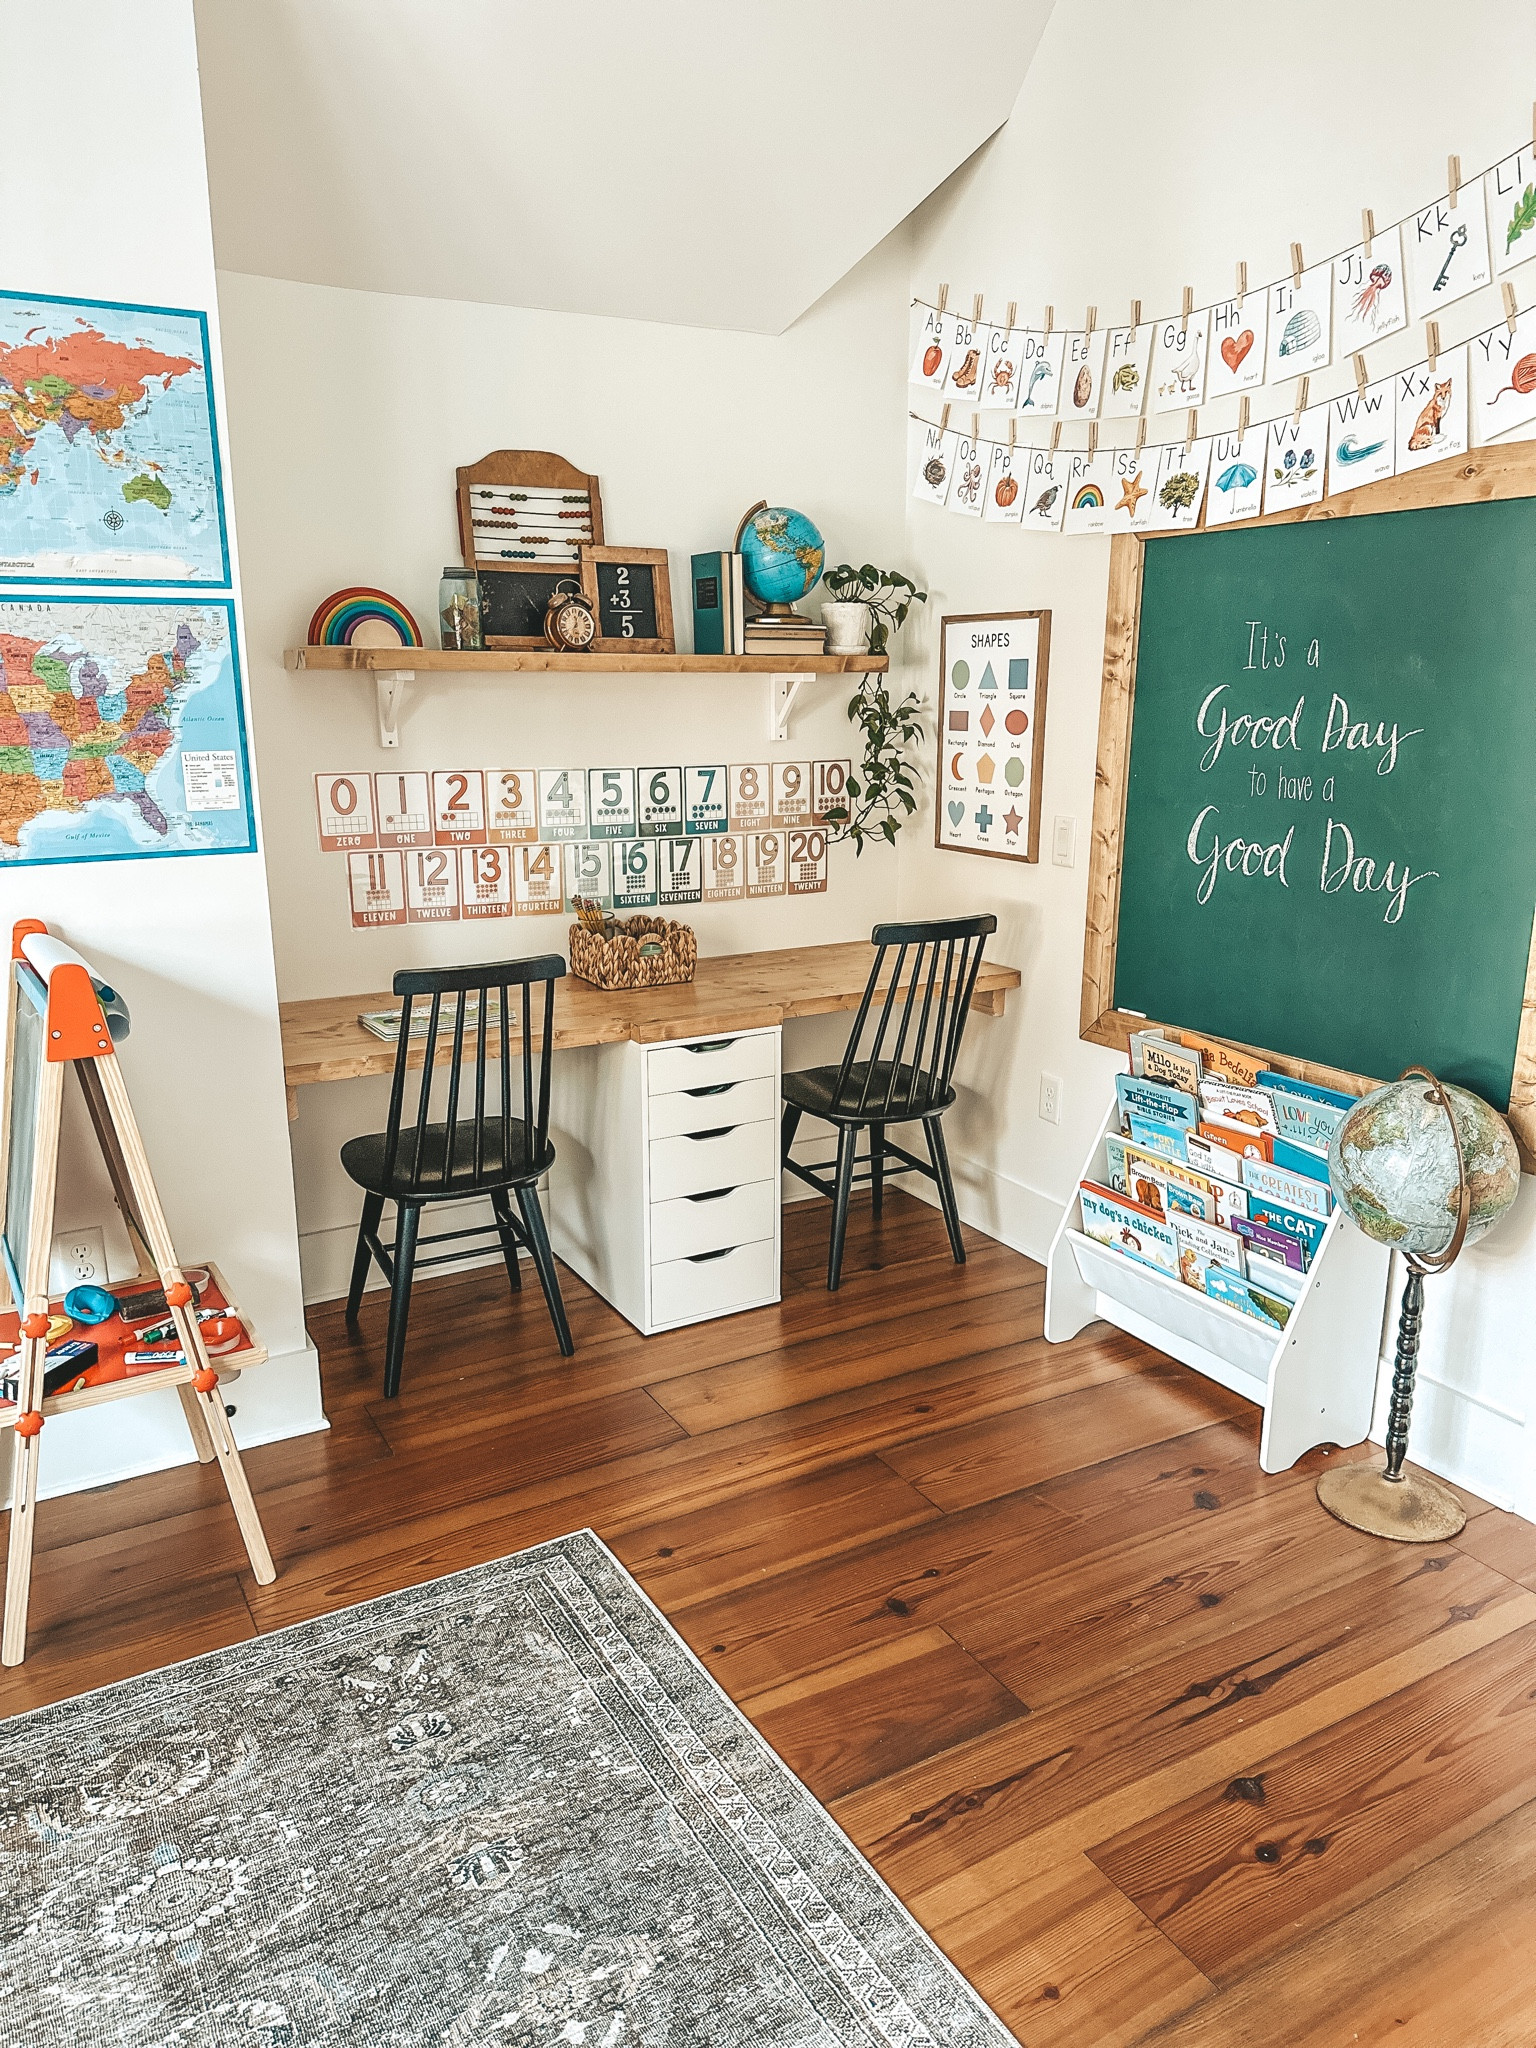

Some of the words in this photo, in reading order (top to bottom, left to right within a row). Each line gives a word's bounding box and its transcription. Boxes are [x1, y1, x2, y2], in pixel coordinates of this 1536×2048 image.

[1416, 205, 1449, 242] Kk
[1339, 254, 1363, 285] Jj
[1276, 287, 1293, 314] Ii
[1215, 303, 1240, 332] Hh
[955, 324, 972, 346] Bb
[991, 334, 1008, 354] Cc
[1112, 333, 1132, 357] Ff
[1163, 324, 1187, 351] Gg
[1479, 333, 1513, 361] Yy
[1071, 339, 1088, 362] Ee
[1400, 372, 1430, 402] Xx
[1336, 395, 1383, 424] Ww
[926, 428, 941, 450] Nn
[1274, 420, 1300, 446] Vv
[960, 441, 976, 461] Oo
[994, 448, 1010, 473] Pp
[1166, 446, 1186, 470] Tt
[1218, 437, 1242, 461] Uu
[1034, 454, 1054, 480] Qq
[1072, 456, 1090, 478] Rr
[1118, 453, 1136, 476] Ss
[616, 567, 630, 585] 2
[1, 604, 51, 612] CANADA
[622, 616, 634, 638] 5
[971, 632, 1010, 648] SHAPES
[1242, 621, 1287, 670] It's
[1306, 638, 1320, 668] a
[979, 692, 997, 700] Triangle
[1197, 684, 1305, 772] Good
[1322, 692, 1424, 776] Day
[184, 754, 210, 762] United
[500, 773, 522, 809] 3
[547, 771, 574, 808] 4
[602, 772, 622, 807] 5
[650, 771, 670, 805] 6
[698, 770, 716, 803] 7
[739, 767, 759, 800] 8
[782, 764, 802, 798] 9
[820, 763, 844, 796] 10
[1248, 764, 1267, 798] to
[1278, 766, 1313, 802] have
[1322, 775, 1335, 802] a
[330, 778, 358, 816] 0
[446, 774, 470, 810] 2
[605, 825, 622, 835] FIVE
[654, 824, 667, 833] SIX
[695, 820, 719, 831] SEVEN
[740, 818, 760, 828] EIGHT
[783, 815, 800, 825] NINE
[336, 836, 361, 846] ZERO
[396, 834, 416, 844] ONE
[450, 832, 471, 842] TWO
[500, 829, 526, 840] THREE
[552, 828, 575, 838] FOUR
[622, 842, 648, 876] 16
[669, 840, 694, 872] 17
[712, 838, 738, 870] 18
[755, 834, 778, 867] 19
[790, 832, 825, 863] 20
[368, 853, 387, 890] 11
[418, 850, 448, 886] 12
[472, 848, 502, 884] 13
[522, 846, 555, 882] 14
[574, 844, 602, 878] 15
[1186, 805, 1295, 906] Good
[1320, 817, 1440, 924] Day
[660, 891, 700, 902] SEVENTEEN
[707, 888, 741, 898] EIGHTEEN
[750, 884, 783, 894] NINETEEN
[794, 881, 822, 891] TWENTY
[467, 904, 508, 916] THIRTEEN
[517, 901, 560, 912] FOURTEEN
[620, 894, 650, 904] SIXTEEN
[363, 912, 396, 922] ELEVEN
[416, 908, 452, 919] TWELVE
[1147, 1050, 1171, 1068] Milo
[1180, 1065, 1192, 1076] Not
[1154, 1064, 1166, 1076] Dog
[1168, 1069, 1188, 1084] Today
[1219, 1052, 1256, 1088] Bedelia
[1132, 1092, 1179, 1116] Lift-the-Flap
[1146, 1089, 1172, 1102] FAVORITE
[1152, 1110, 1176, 1122] STORIES
[1246, 1100, 1268, 1116] School
[1283, 1104, 1312, 1126] LOVE
[1204, 1130, 1228, 1146] Green
[1132, 1168, 1150, 1182] Brown
[1262, 1174, 1318, 1205] GREATEST
[1082, 1197, 1097, 1214] my
[1100, 1203, 1122, 1222] dog's
[1124, 1216, 1130, 1226] a
[1132, 1218, 1173, 1246] chicken
[1262, 1208, 1282, 1224] THE
[1284, 1215, 1316, 1238] CAT
[1179, 1238, 1200, 1252] eading
[1201, 1247, 1230, 1264] Collection
[1196, 1236, 1208, 1245] and
[1210, 1240, 1236, 1258] Jane
